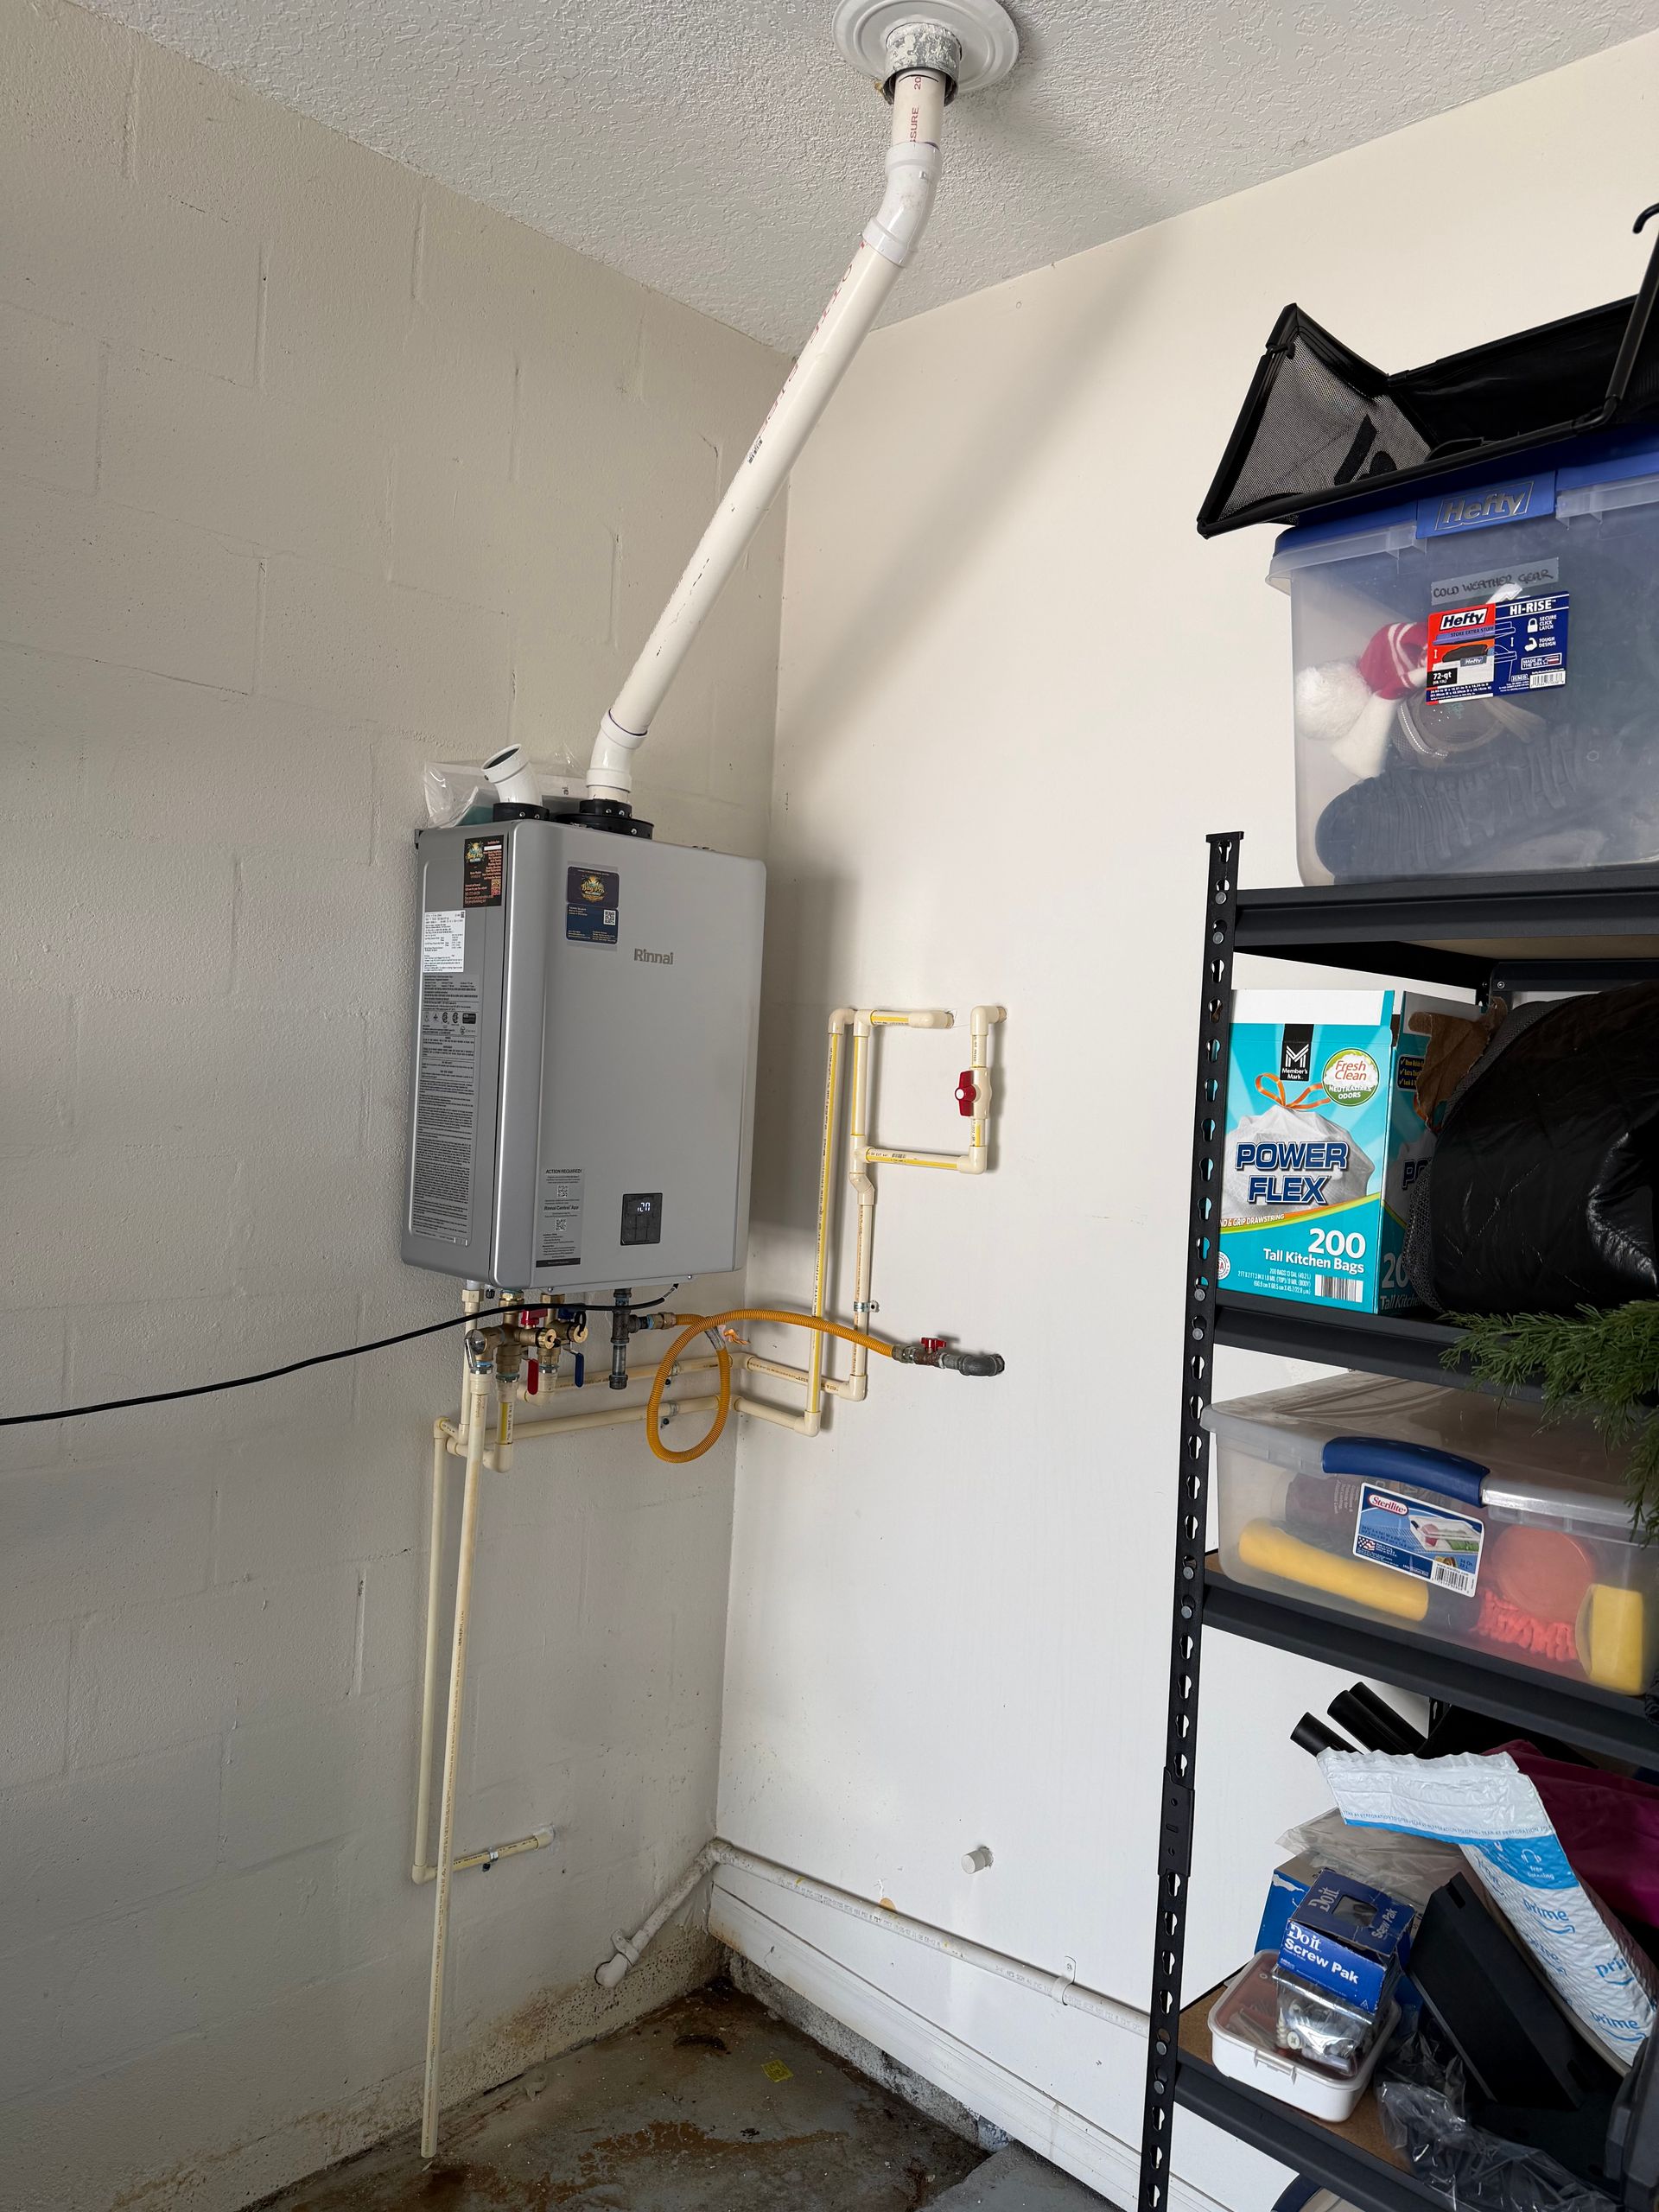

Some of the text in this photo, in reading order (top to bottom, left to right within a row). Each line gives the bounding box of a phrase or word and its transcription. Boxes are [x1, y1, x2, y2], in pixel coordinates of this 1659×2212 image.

[1443, 492, 1525, 524] Hefty
[1433, 569, 1554, 598] COLD WEATHER GEAR
[1443, 613, 1484, 628] Hefty
[1433, 671, 1452, 680] 72-qt
[633, 948, 674, 965] Rinnai
[1335, 1070, 1367, 1081] Clean
[1336, 1060, 1366, 1071] Fresh
[1338, 1091, 1362, 1100] ODORS
[1235, 1141, 1349, 1171] POWER
[1248, 1175, 1331, 1205] FLEX
[1232, 1217, 1246, 1226] GRIP
[1246, 1213, 1285, 1224] DRAWSTRING
[1308, 1228, 1366, 1259] 200
[1262, 1248, 1364, 1275] Tall Kitchen Bags
[1372, 1496, 1406, 1513] Sterilite
[1522, 1897, 1570, 1922] prime
[1284, 1938, 1329, 1968] Screw
[1332, 1961, 1359, 1985] Pak
[1590, 2010, 1641, 2030] prime
